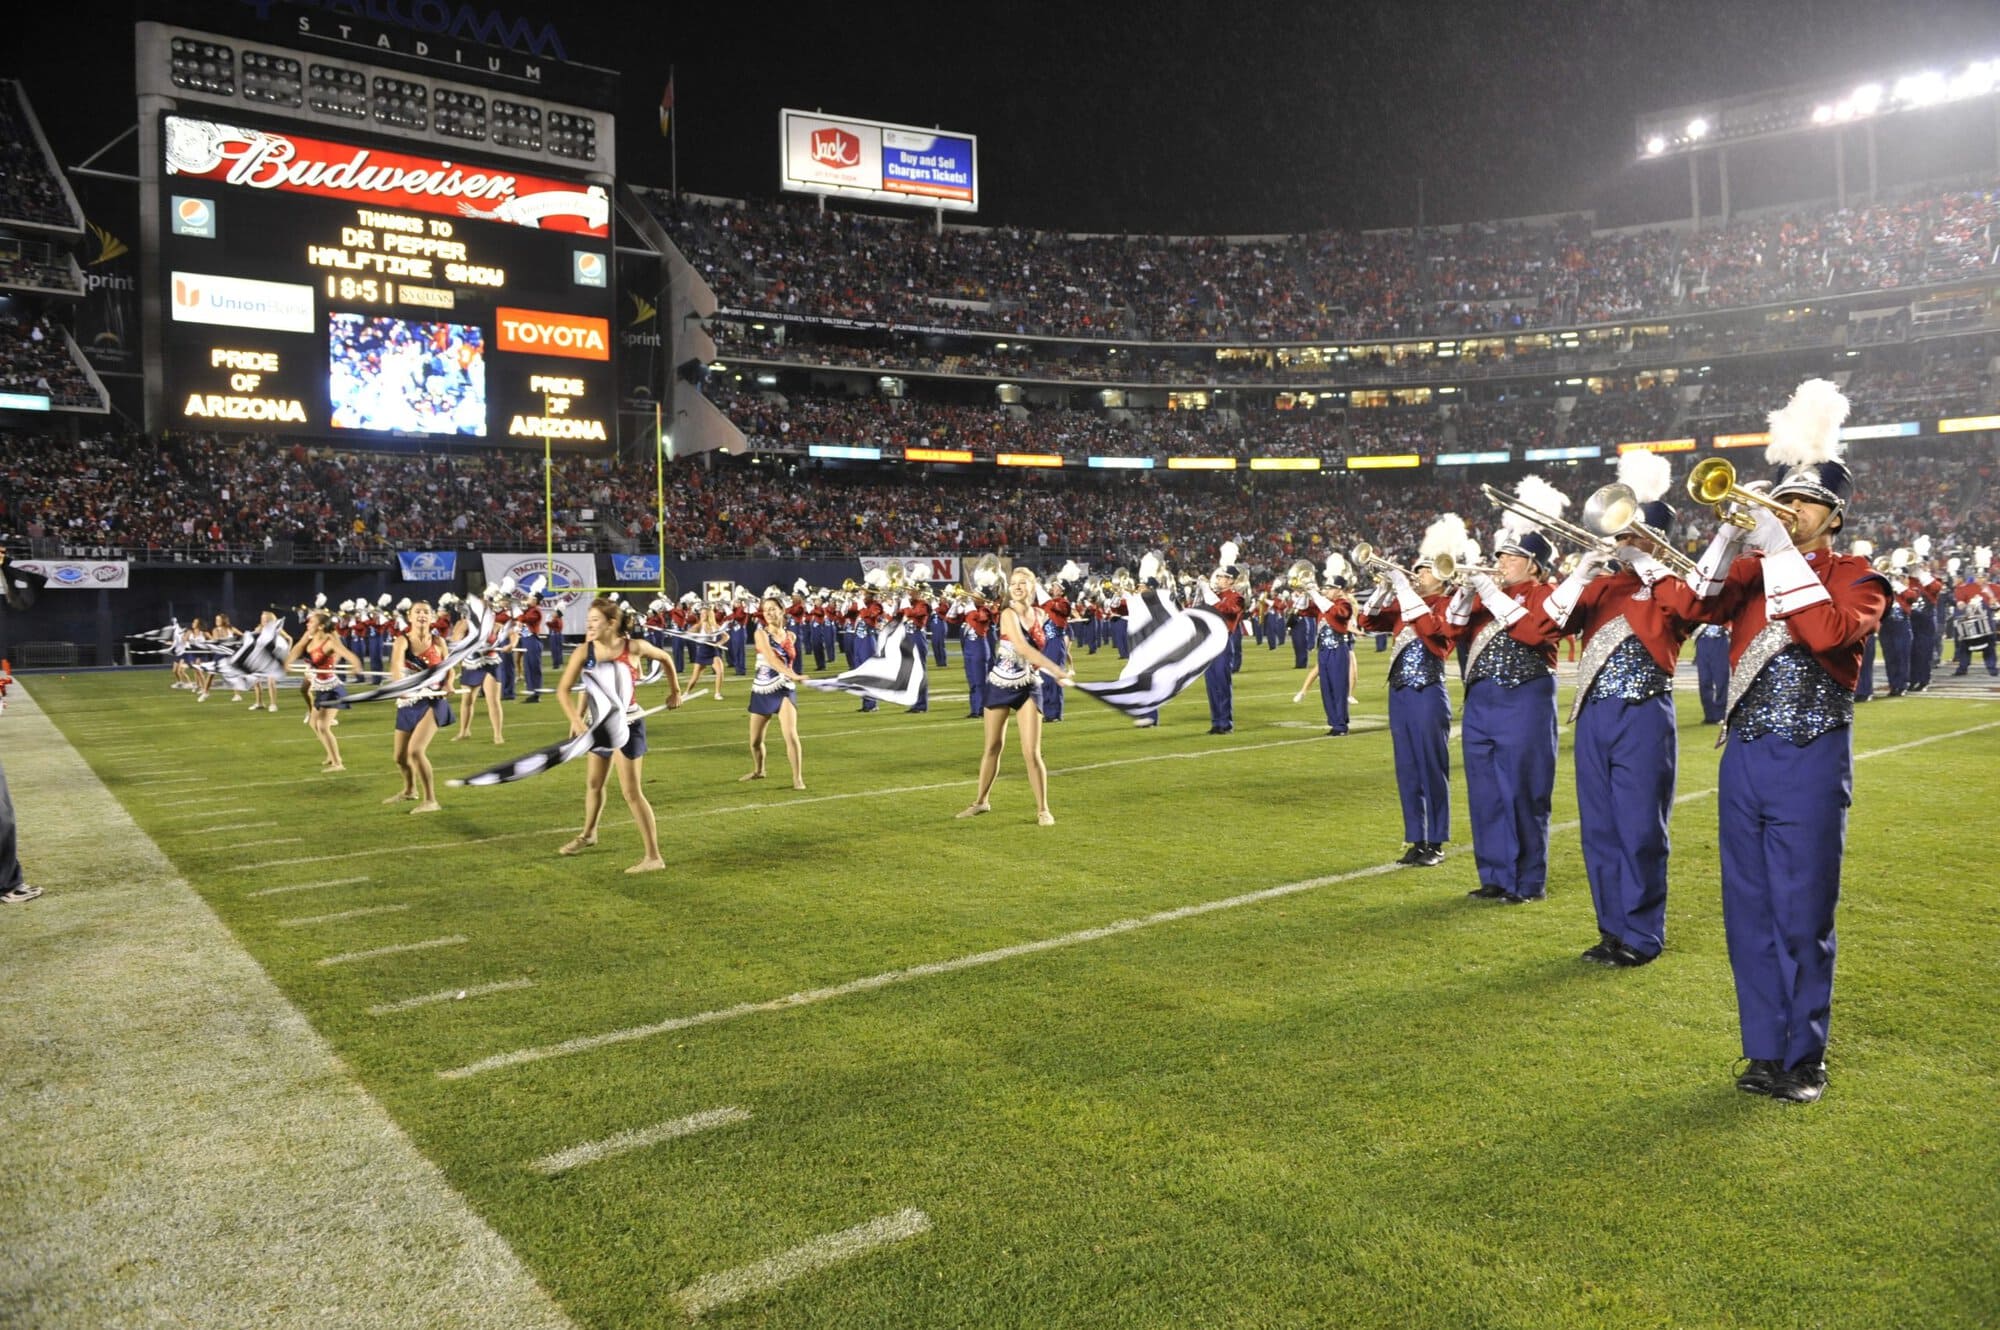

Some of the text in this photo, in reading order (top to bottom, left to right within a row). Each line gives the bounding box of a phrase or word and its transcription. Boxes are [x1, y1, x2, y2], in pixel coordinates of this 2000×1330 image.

[299, 15, 541, 79] STADIUM
[812, 131, 859, 165] Jack
[900, 151, 955, 169] Buy and Sell
[212, 133, 516, 199] Budweiser
[888, 163, 967, 185] Chargers Tickets!
[428, 219, 453, 237] TO
[342, 227, 467, 261] DR PEPPER
[445, 263, 505, 287] SHOW
[502, 320, 604, 350] TOYOTA
[211, 348, 279, 372] PRIDE
[230, 373, 261, 392] OF
[530, 375, 584, 396] PRIDE
[184, 394, 307, 422] ARIZONA
[509, 415, 606, 440] ARIZONA
[513, 562, 548, 577] PACIFIC
[931, 559, 953, 580] N
